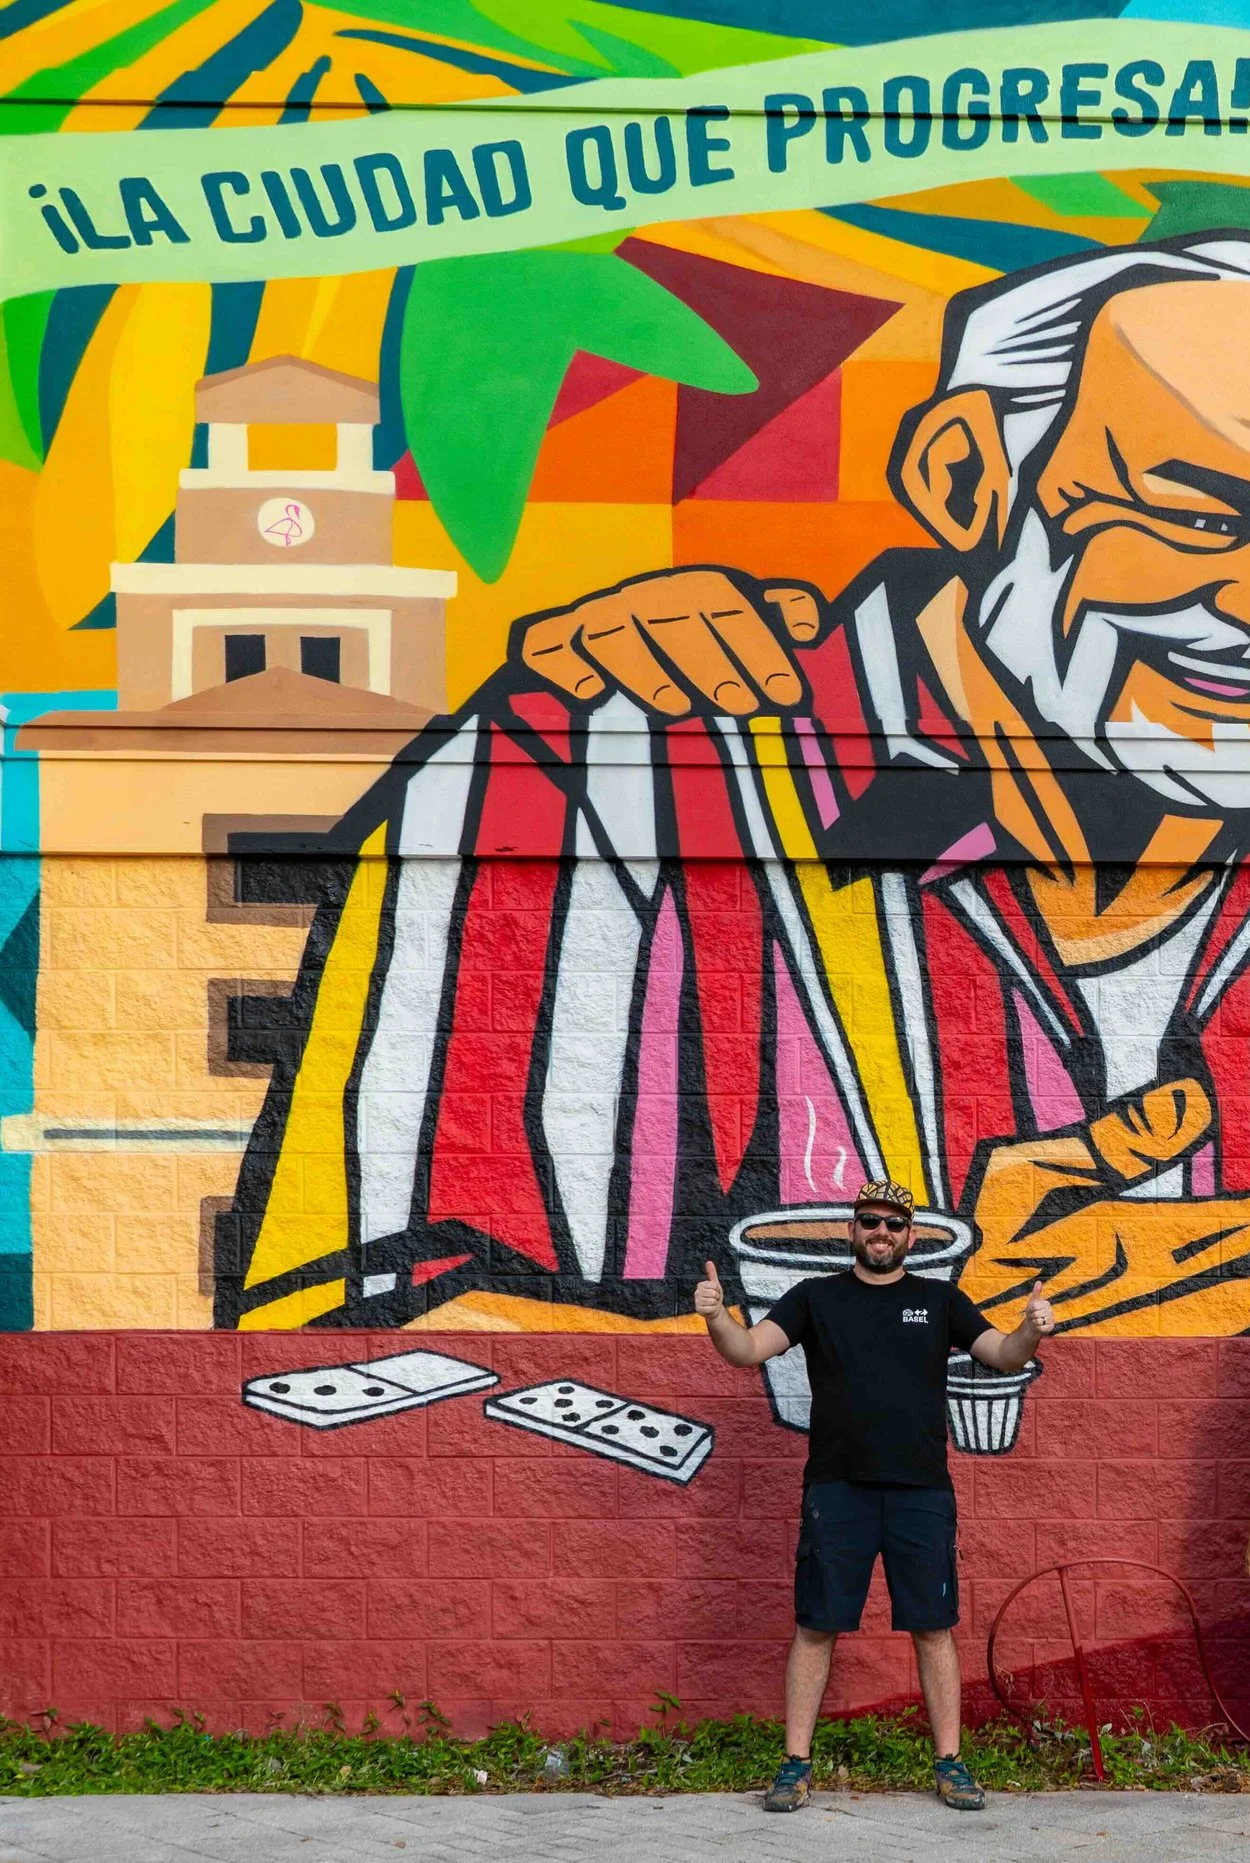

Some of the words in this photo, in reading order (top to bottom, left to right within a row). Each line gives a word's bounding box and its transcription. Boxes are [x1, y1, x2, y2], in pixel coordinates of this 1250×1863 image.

[28, 178, 190, 254] ¡LA
[201, 140, 532, 243] CIUDAD
[566, 106, 735, 211] QUE
[902, 1316, 929, 1324] BASEL
